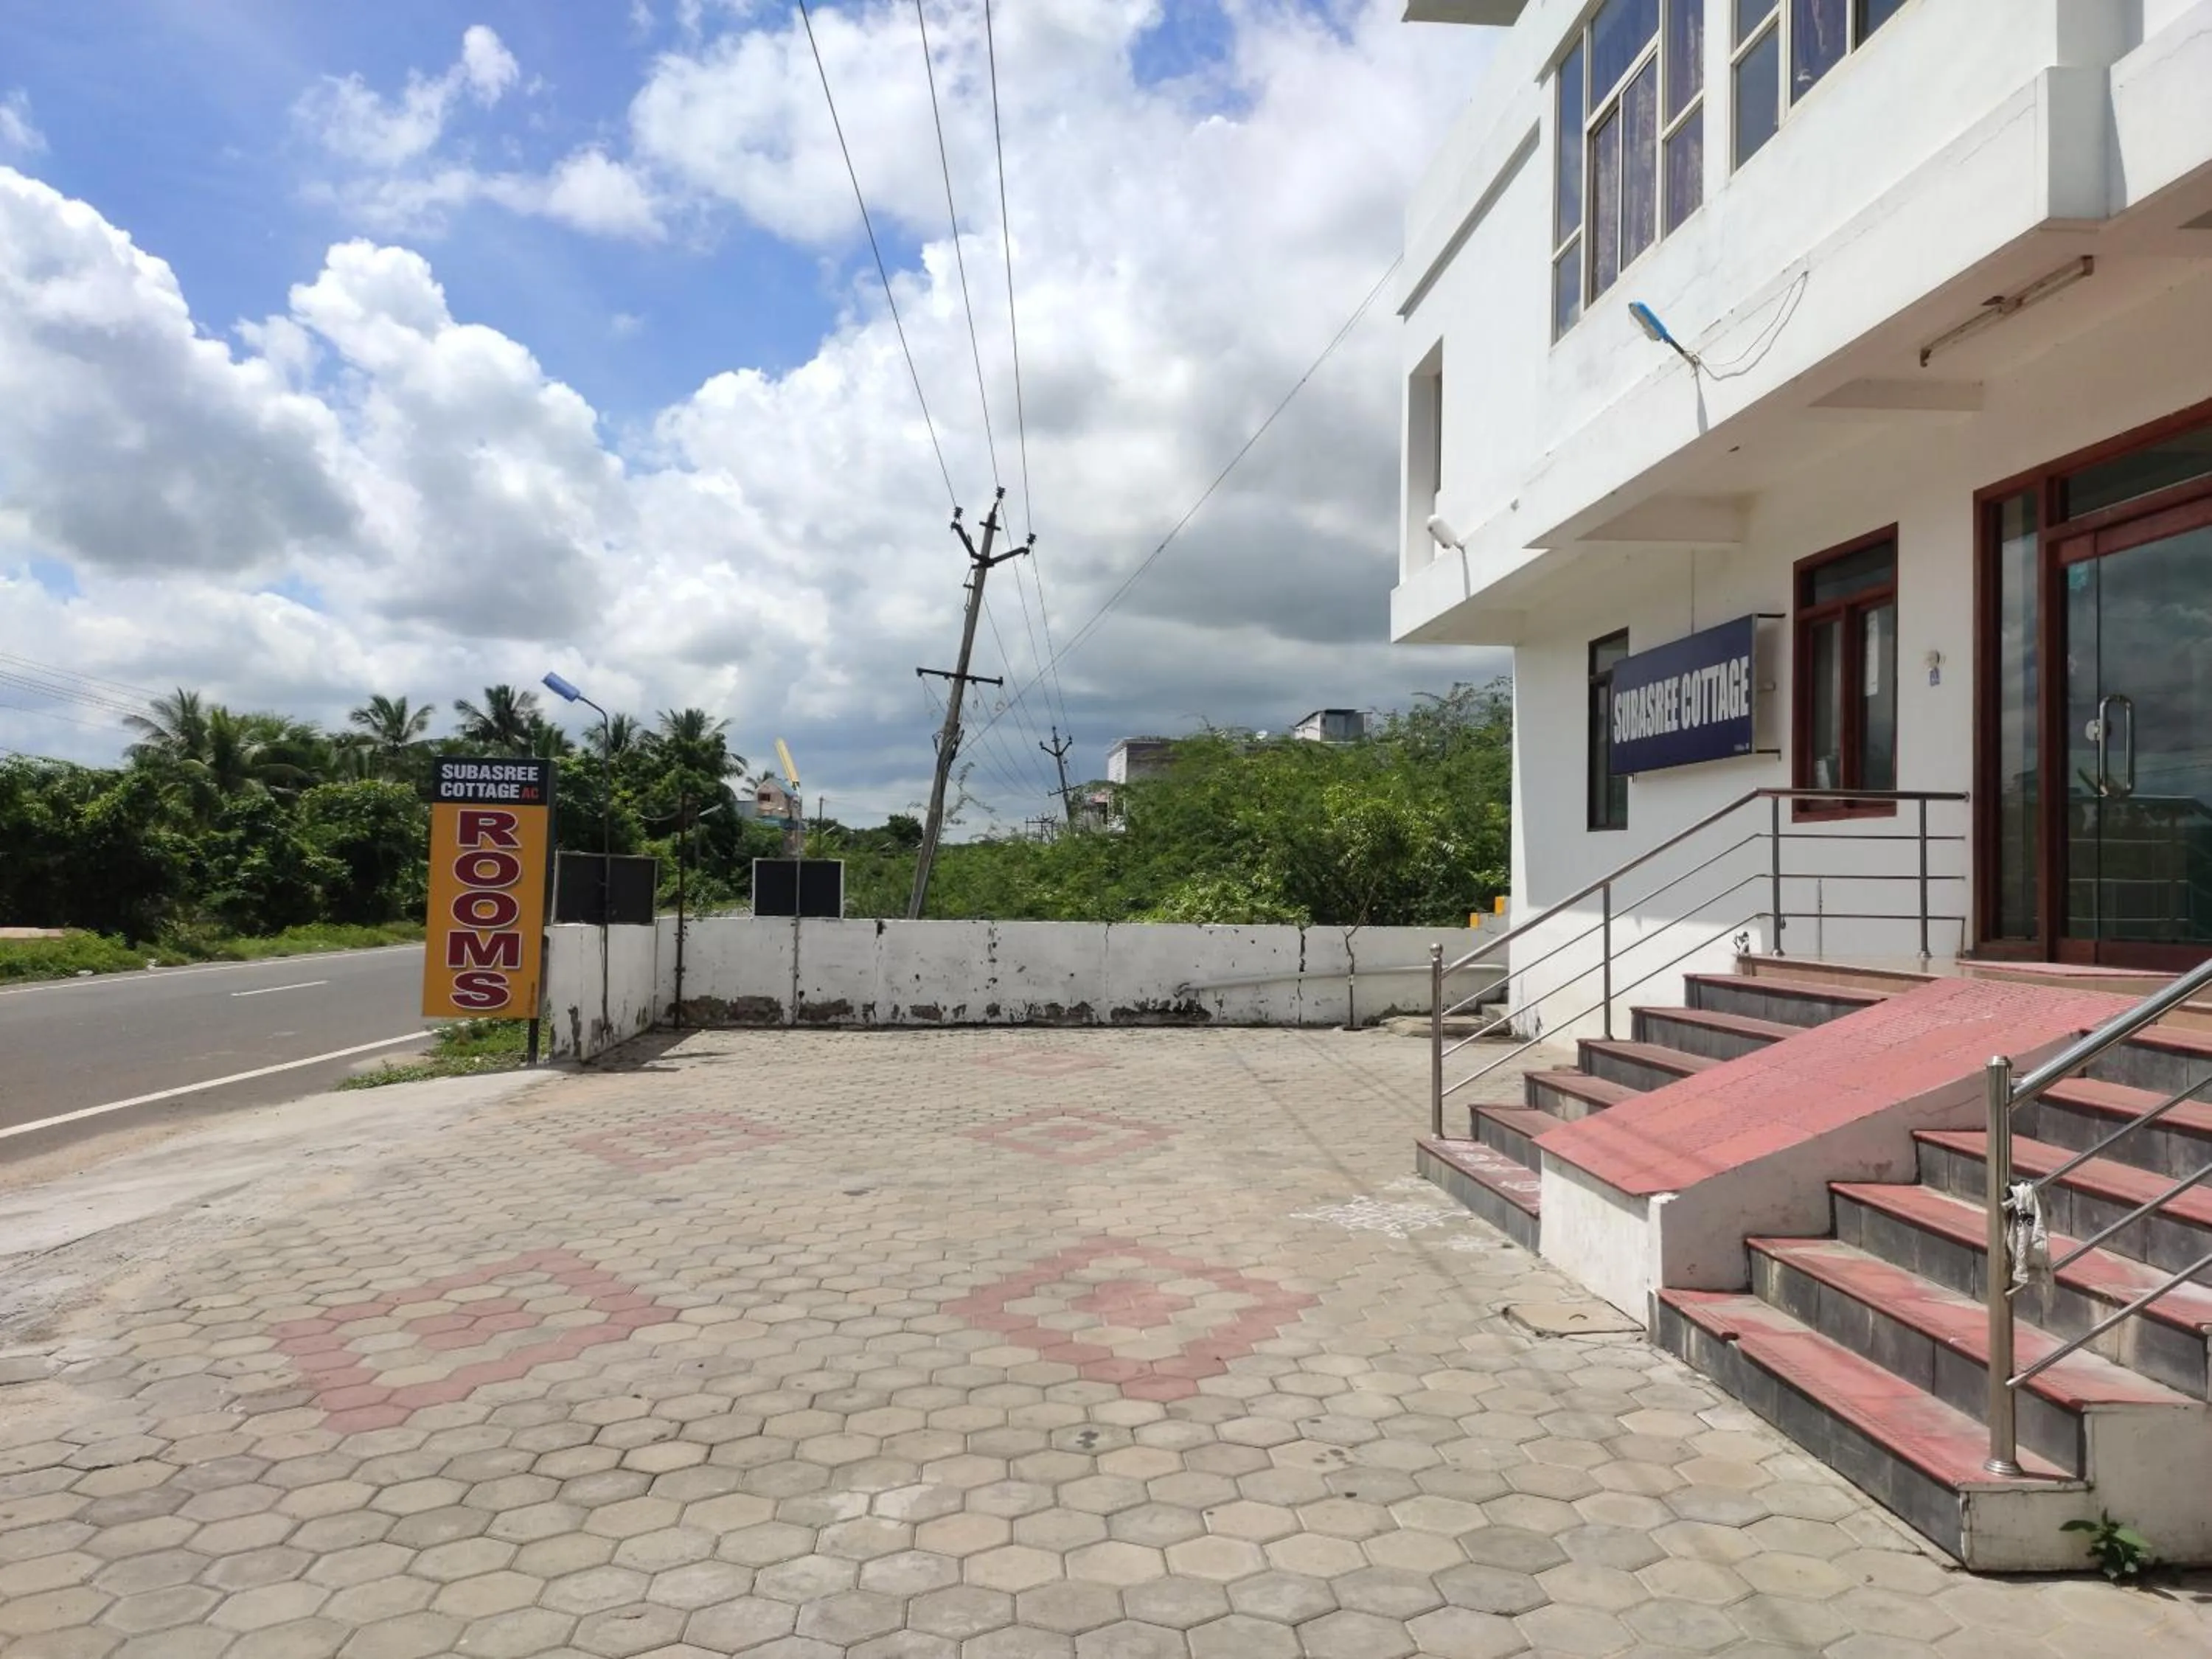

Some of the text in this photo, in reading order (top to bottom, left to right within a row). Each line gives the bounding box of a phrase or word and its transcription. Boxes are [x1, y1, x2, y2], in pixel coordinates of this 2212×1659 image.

[1613, 656, 1749, 743] SUBASREE COTTAGE
[440, 782, 540, 799] COTTAGE AC
[442, 763, 539, 781] SUBASREE
[447, 810, 521, 1009] ROOMS
